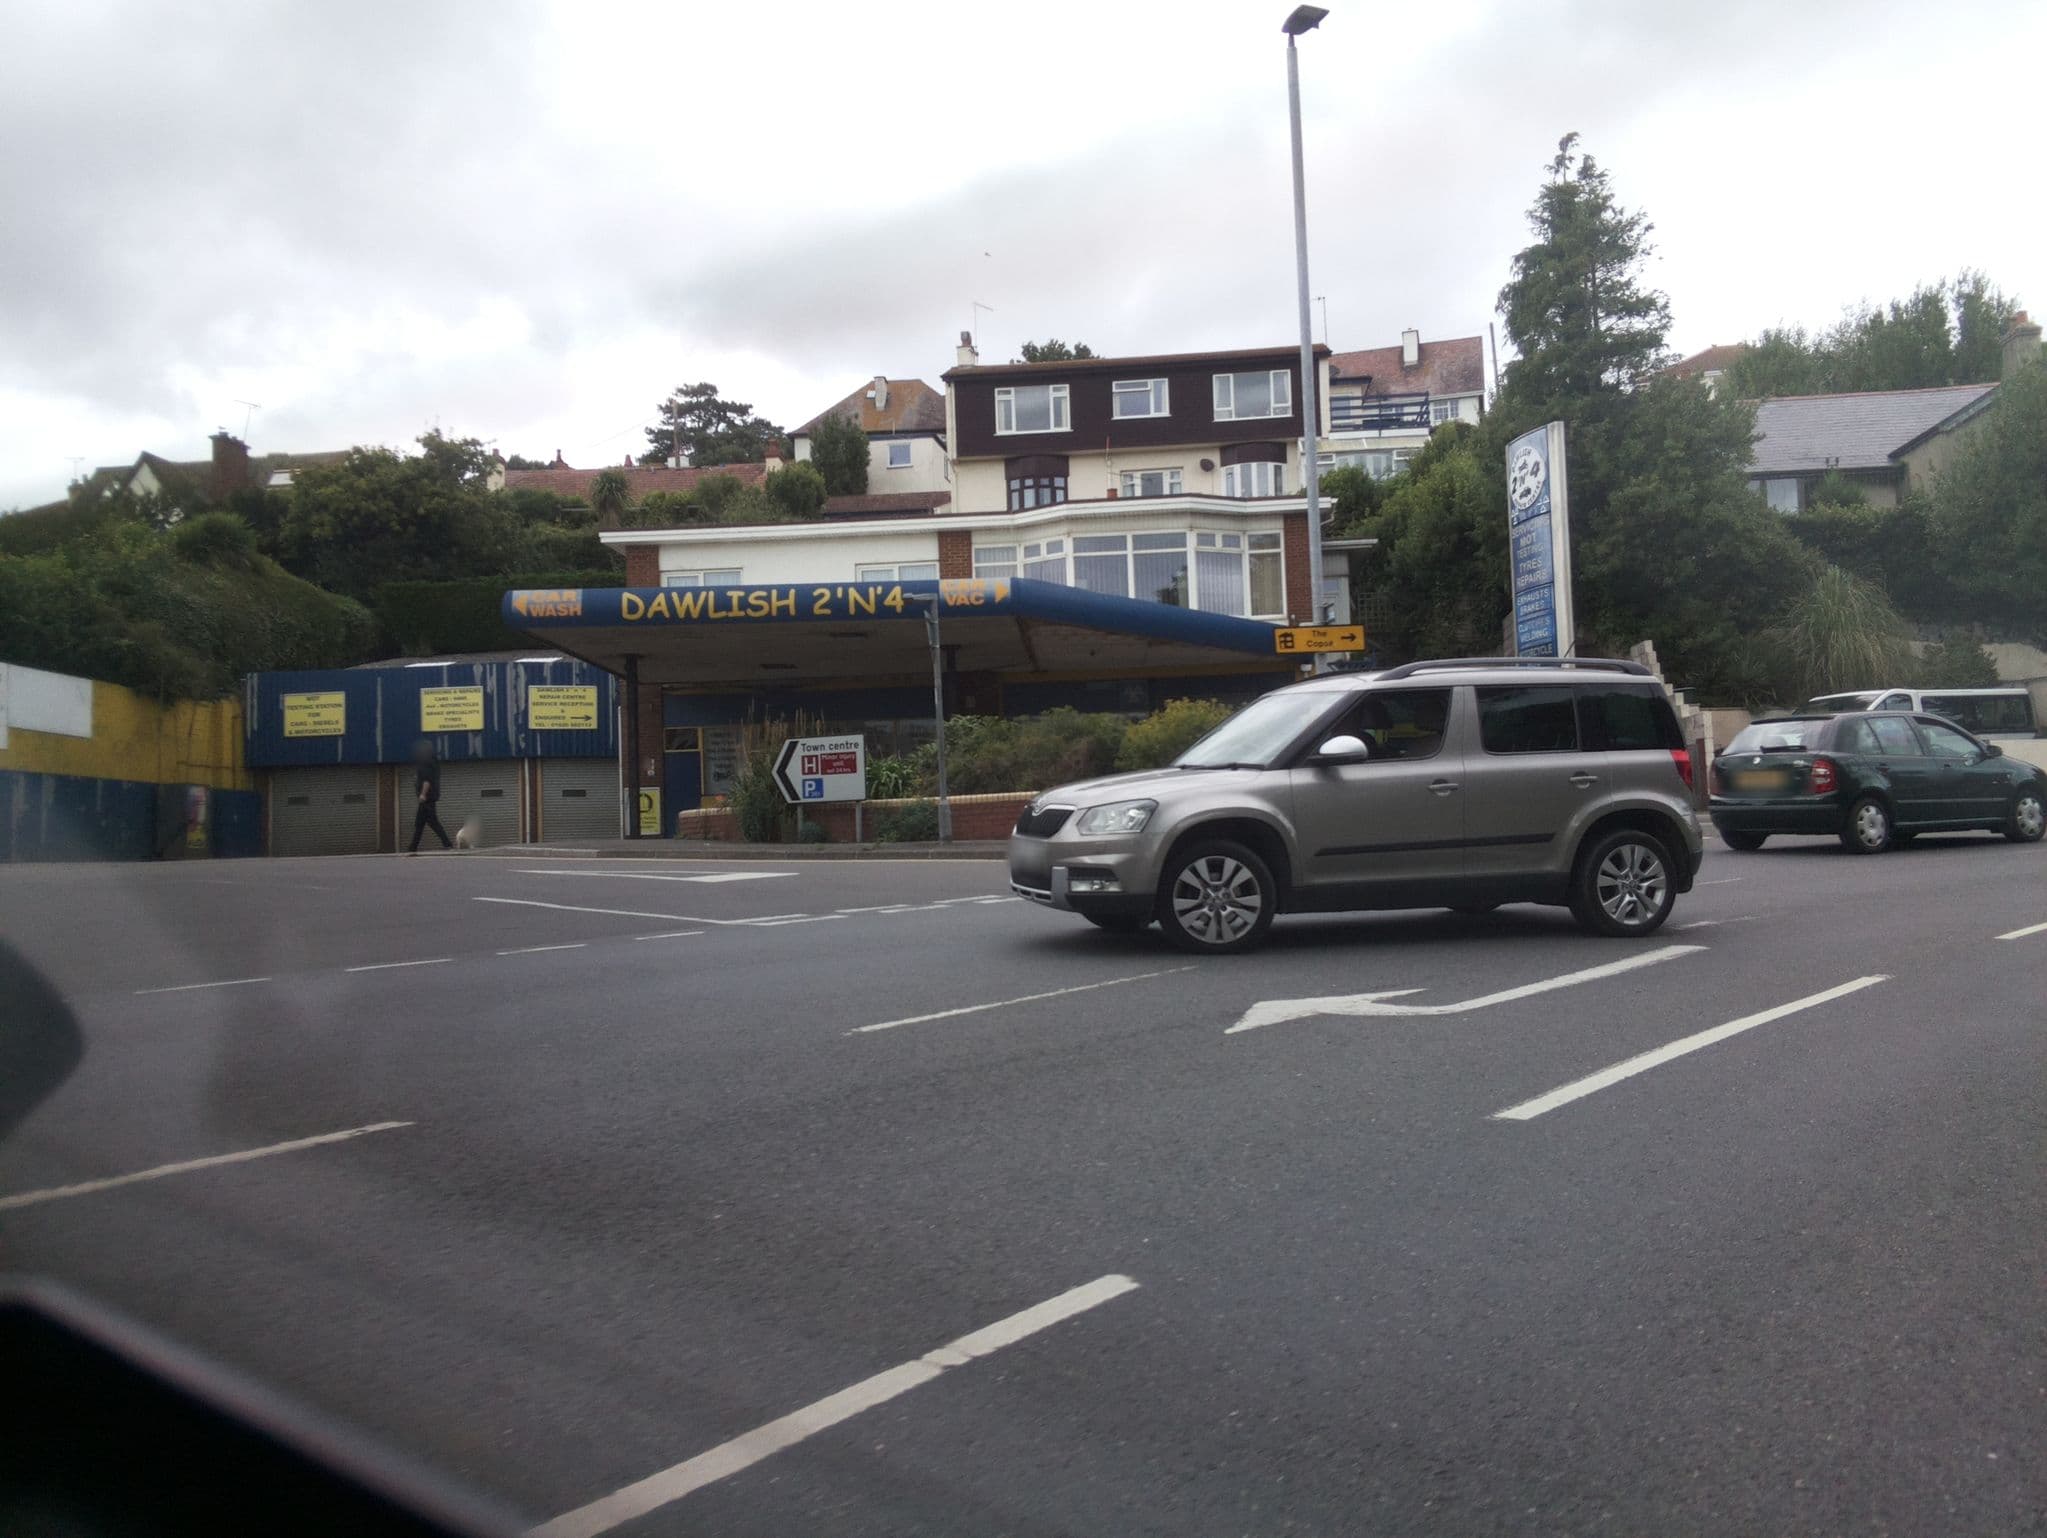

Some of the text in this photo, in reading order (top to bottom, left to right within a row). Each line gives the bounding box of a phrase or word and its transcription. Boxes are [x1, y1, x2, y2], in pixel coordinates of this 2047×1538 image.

[1520, 532, 1537, 547] MOT
[1519, 557, 1543, 574] TYRES
[1516, 570, 1547, 587] REPAIRS
[621, 589, 795, 621] DAWLISH
[944, 590, 985, 606] VAC
[1516, 588, 1549, 606] EXHAUSTS
[530, 602, 582, 617] WASH
[1519, 600, 1545, 616] BRAKES
[1312, 630, 1328, 638] The
[801, 741, 860, 752] Town centre
[804, 757, 817, 773] H
[804, 781, 816, 797] P
